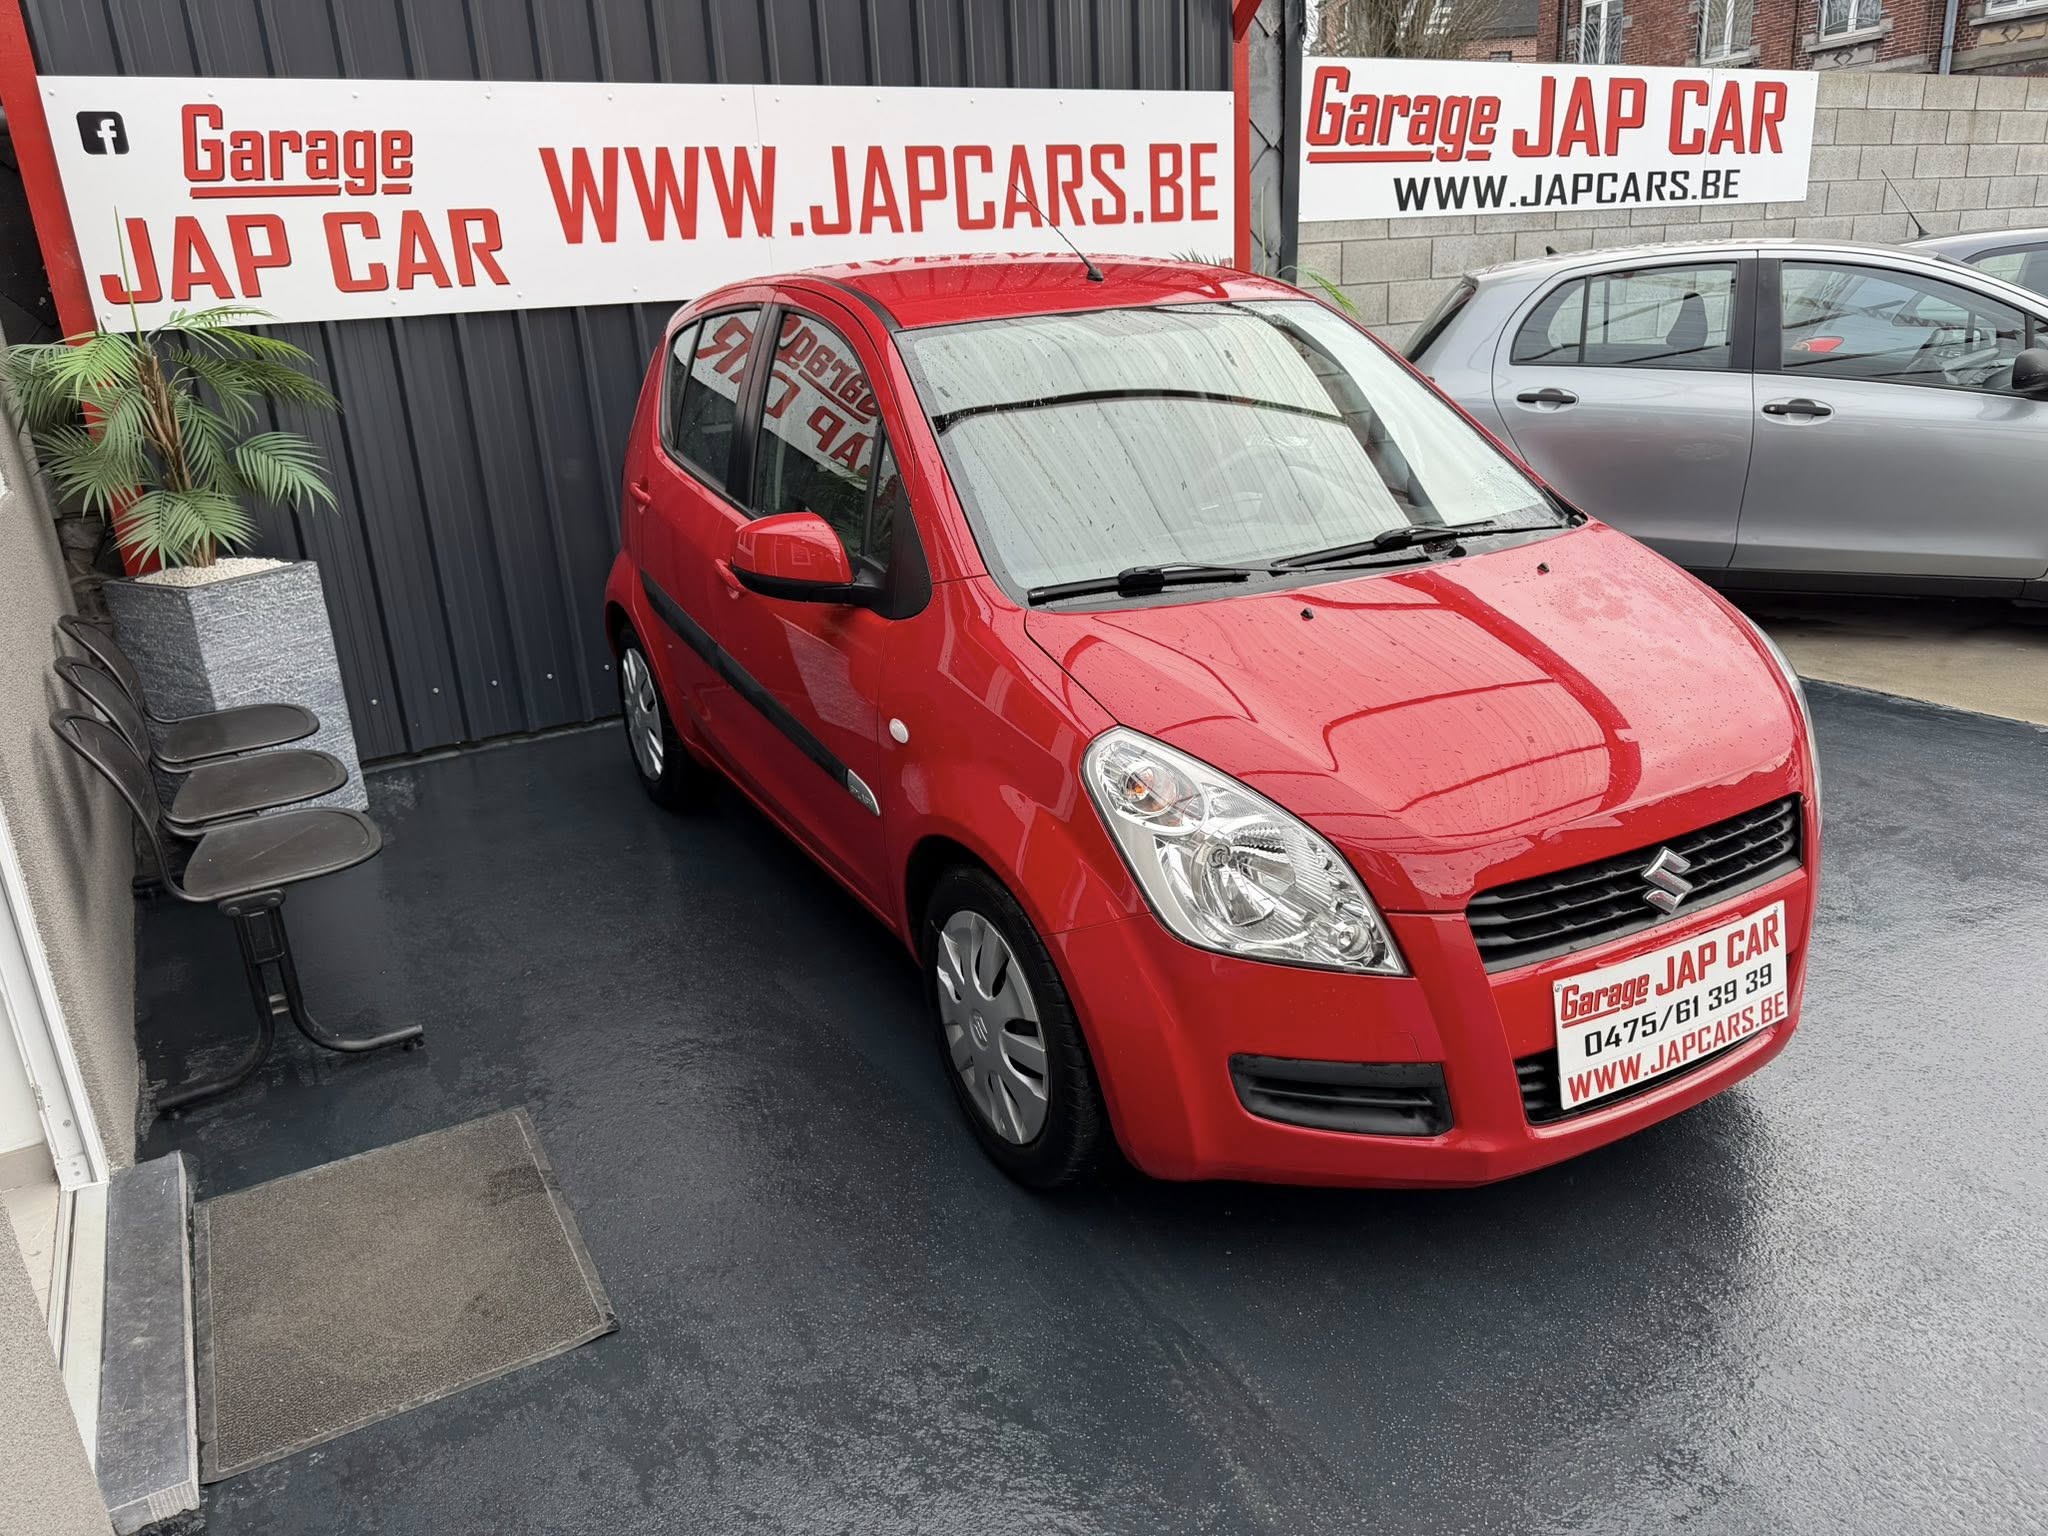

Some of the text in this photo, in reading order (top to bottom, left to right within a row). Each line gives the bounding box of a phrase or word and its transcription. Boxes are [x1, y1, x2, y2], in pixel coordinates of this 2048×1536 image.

[181, 103, 413, 197] Garage
[1306, 64, 1788, 163] Garage JAP CAR
[539, 143, 1219, 245] WWW.JAPCARS.BE
[1393, 169, 1741, 212] WWW.JAPCARS.BE
[100, 208, 510, 305] JAP CAR
[1560, 913, 1780, 1023] Garage JAP CAR
[1584, 962, 1773, 1058] 0475/61 39 39
[1568, 991, 1785, 1103] WWW.JAPCARS.BE
